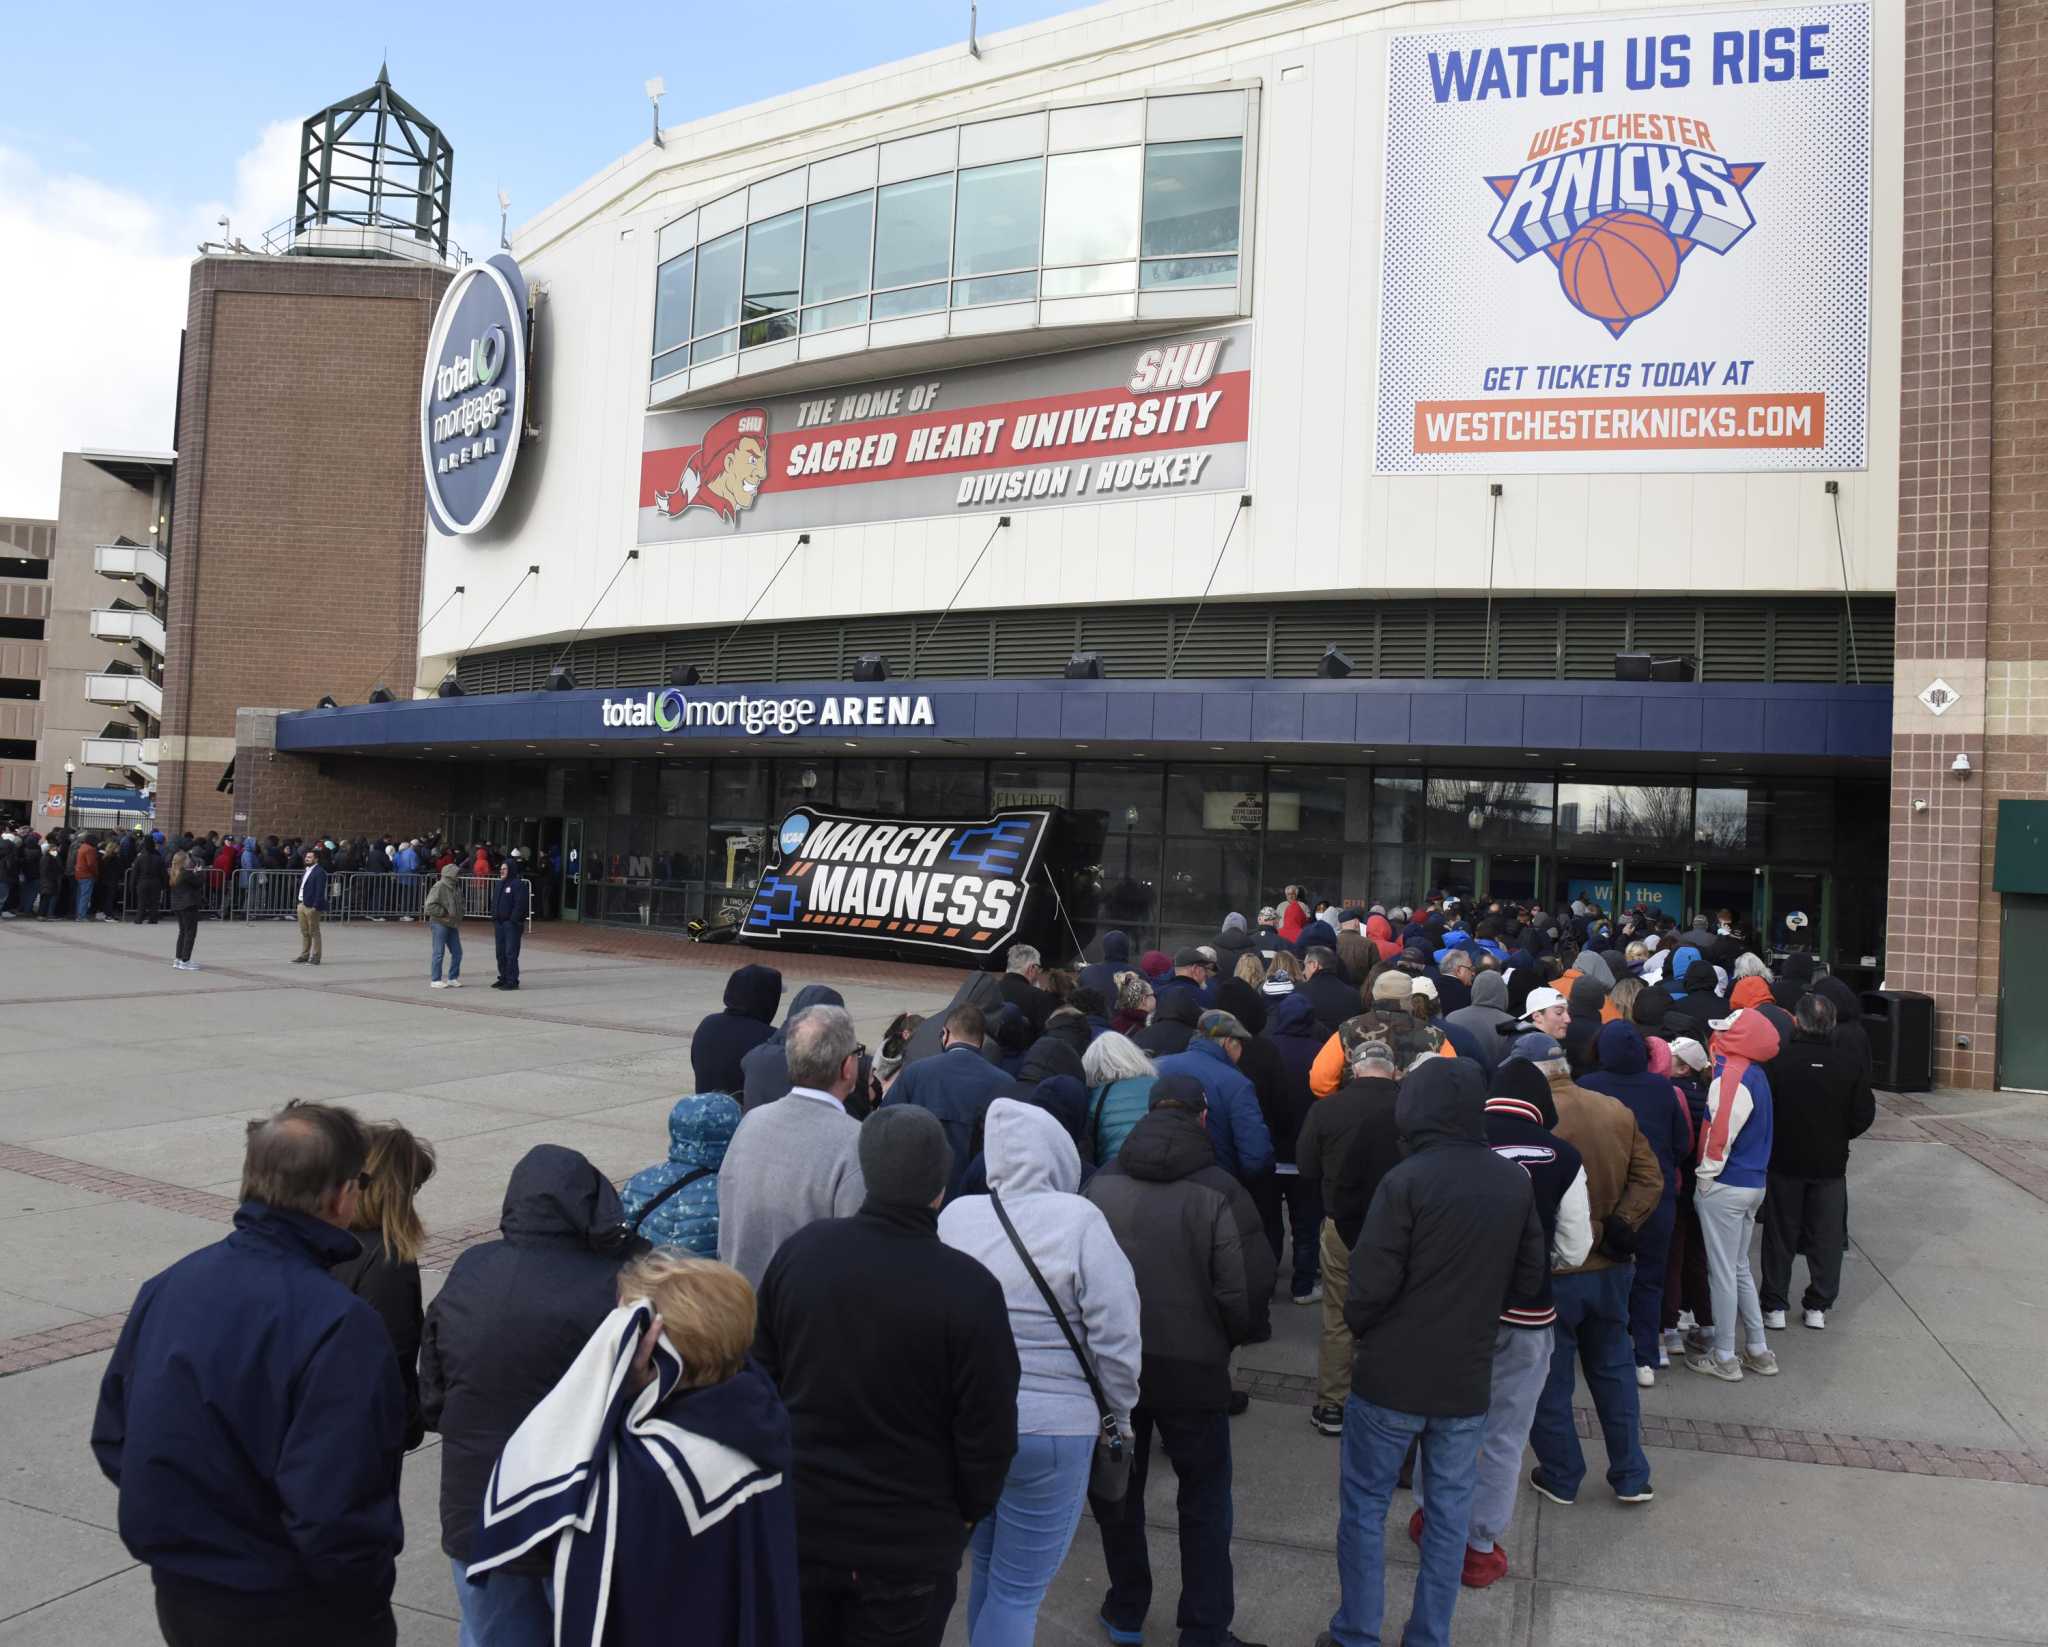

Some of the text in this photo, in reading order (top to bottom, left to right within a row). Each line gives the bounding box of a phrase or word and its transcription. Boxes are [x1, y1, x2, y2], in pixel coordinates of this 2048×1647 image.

[1427, 24, 1830, 104] WATCH US RISE
[1526, 112, 1717, 162] WESTCHESTER
[1488, 142, 1757, 262] KNICKS
[437, 338, 479, 402] total
[1128, 337, 1228, 394] SHU
[1483, 360, 1754, 392] GET TICKETS TODAY AT
[434, 387, 506, 442] mortgage
[738, 416, 763, 433] SHU
[796, 382, 941, 427] THE HOME OF
[1424, 406, 1812, 443] WESTCHESTERKNICKS.COM
[438, 437, 496, 474] ARENA
[786, 390, 1224, 479] SACRED HEART UNIVERSITY
[956, 452, 1212, 506] DIVISION I HOCKEY
[602, 691, 935, 735] total mortgage ARENA
[800, 821, 955, 867] MARCH
[808, 865, 1017, 929] MADNESS
[1594, 885, 1663, 903] Wi the
